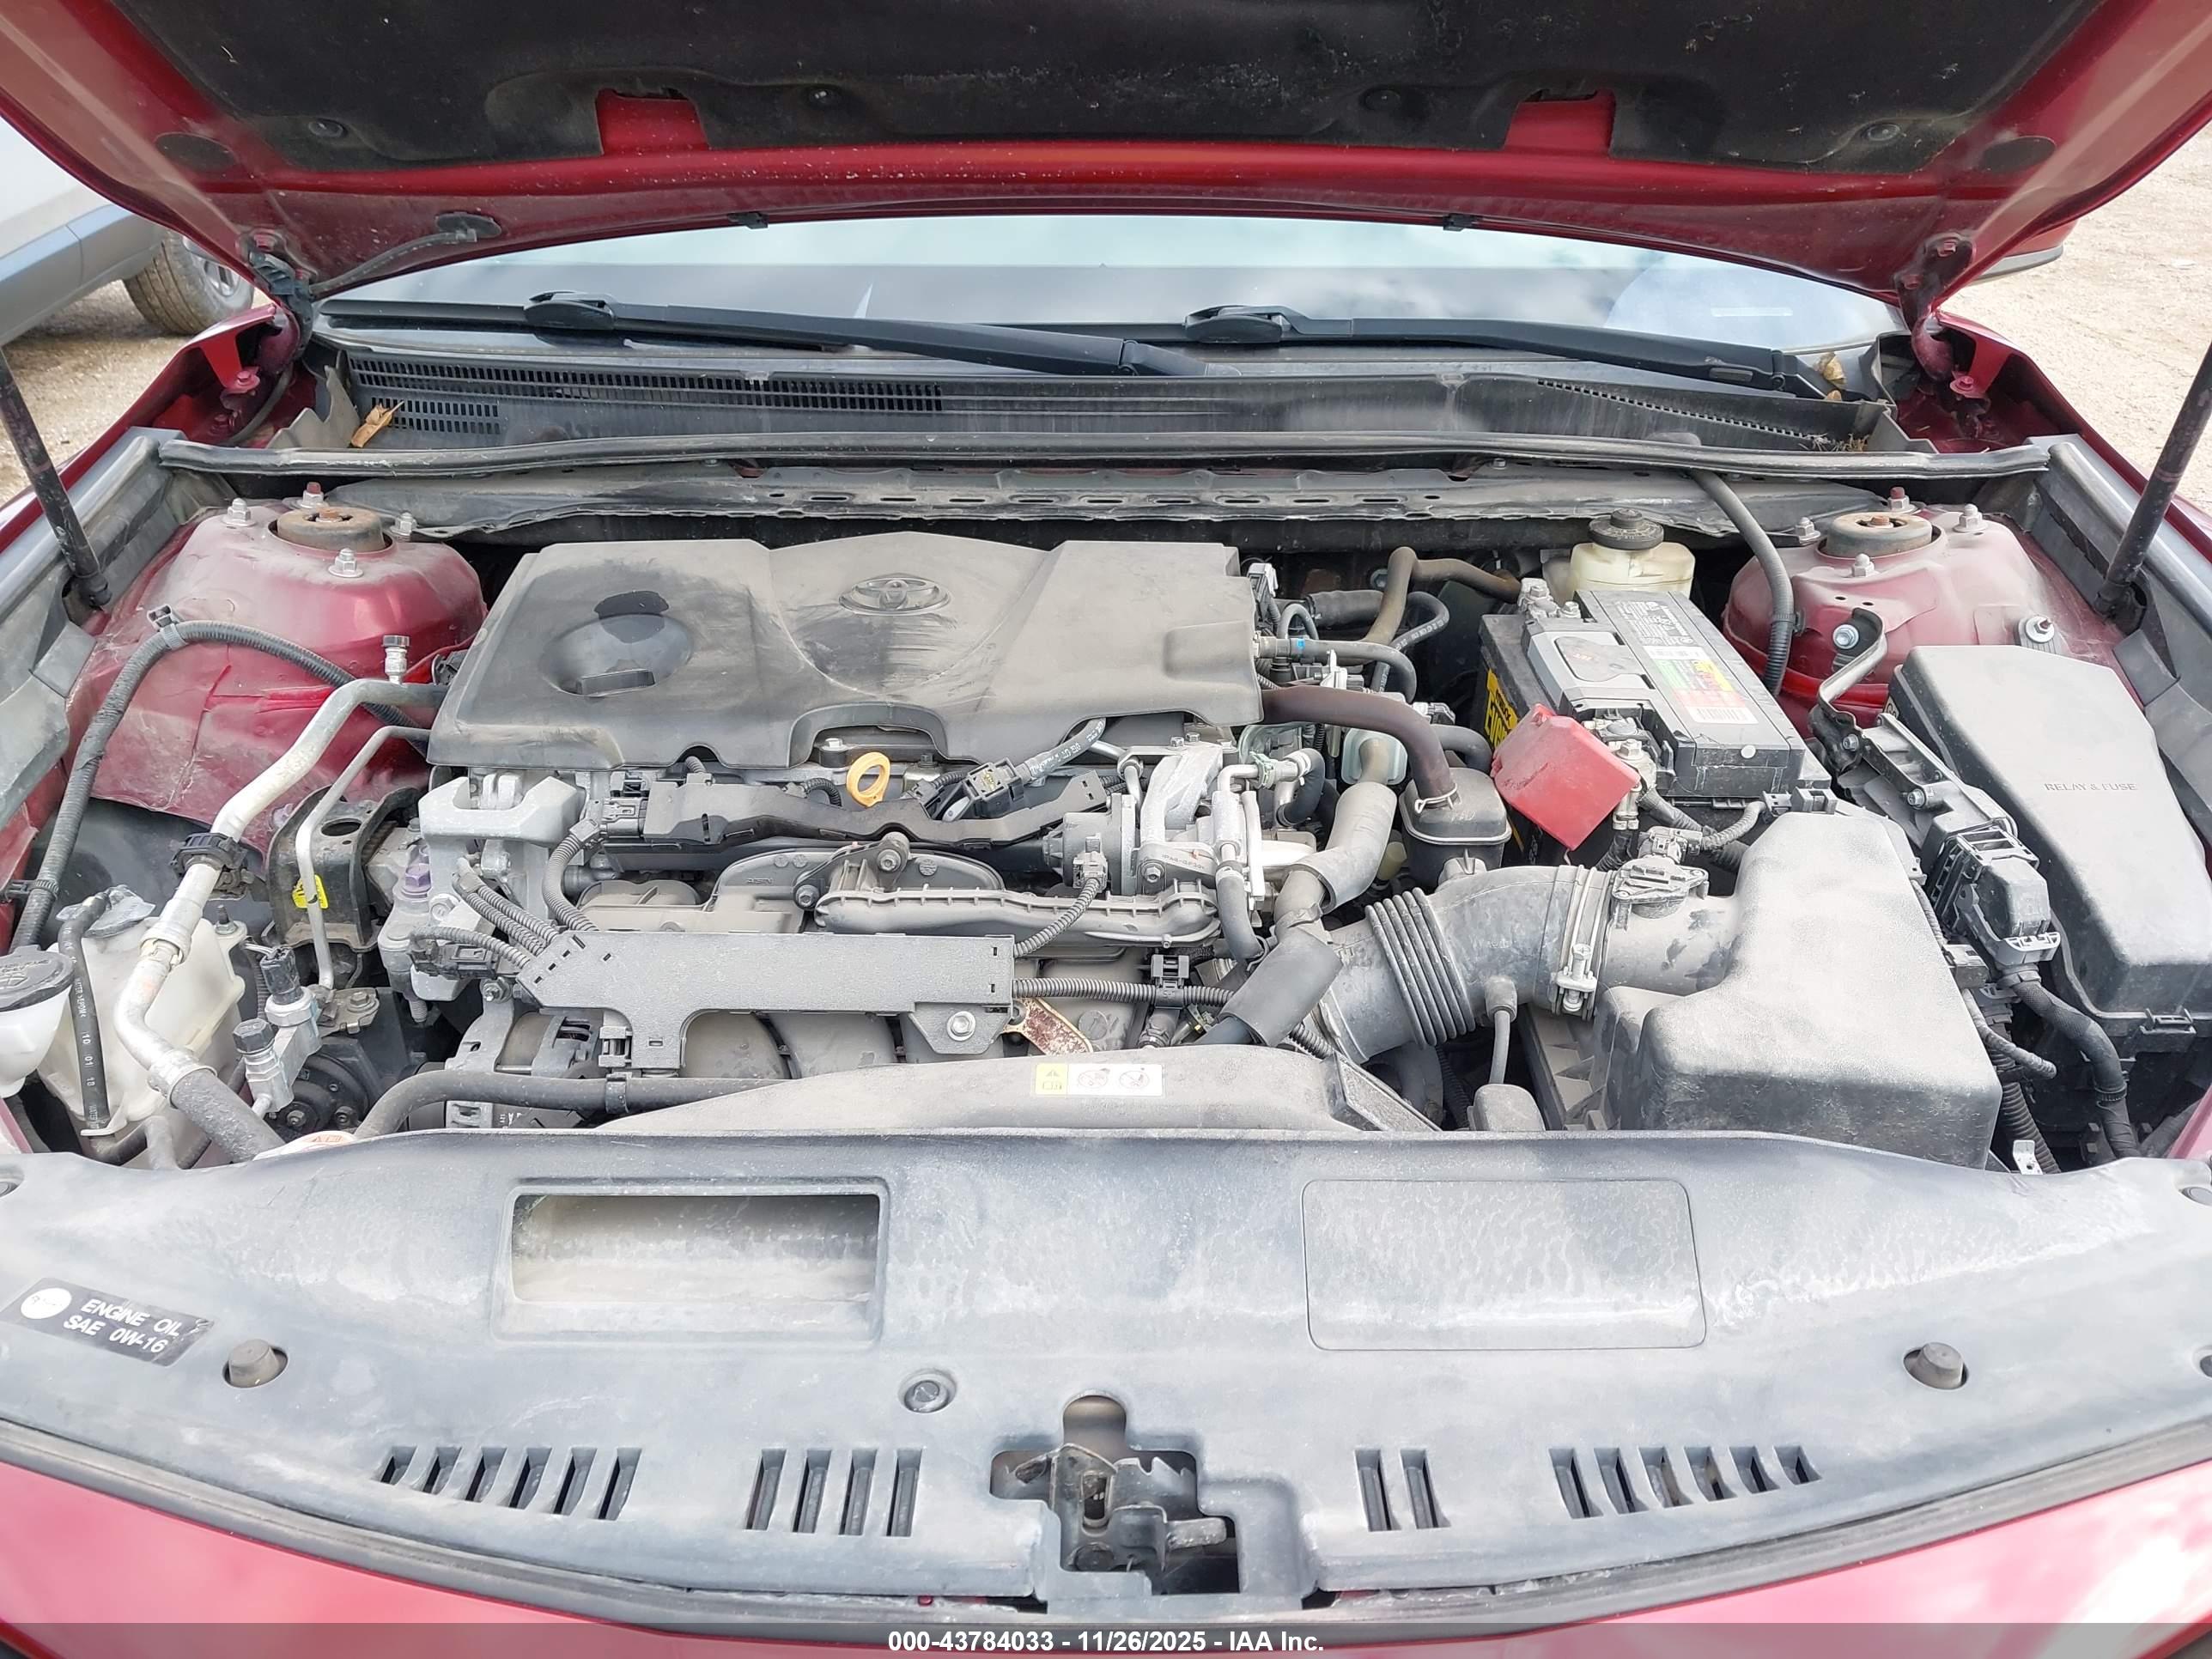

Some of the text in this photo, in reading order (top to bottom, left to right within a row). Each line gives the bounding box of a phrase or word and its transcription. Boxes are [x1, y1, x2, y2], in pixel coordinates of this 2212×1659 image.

[63, 1315, 169, 1353] SAE 0W-16
[81, 1298, 183, 1337] ENGINE OIL
